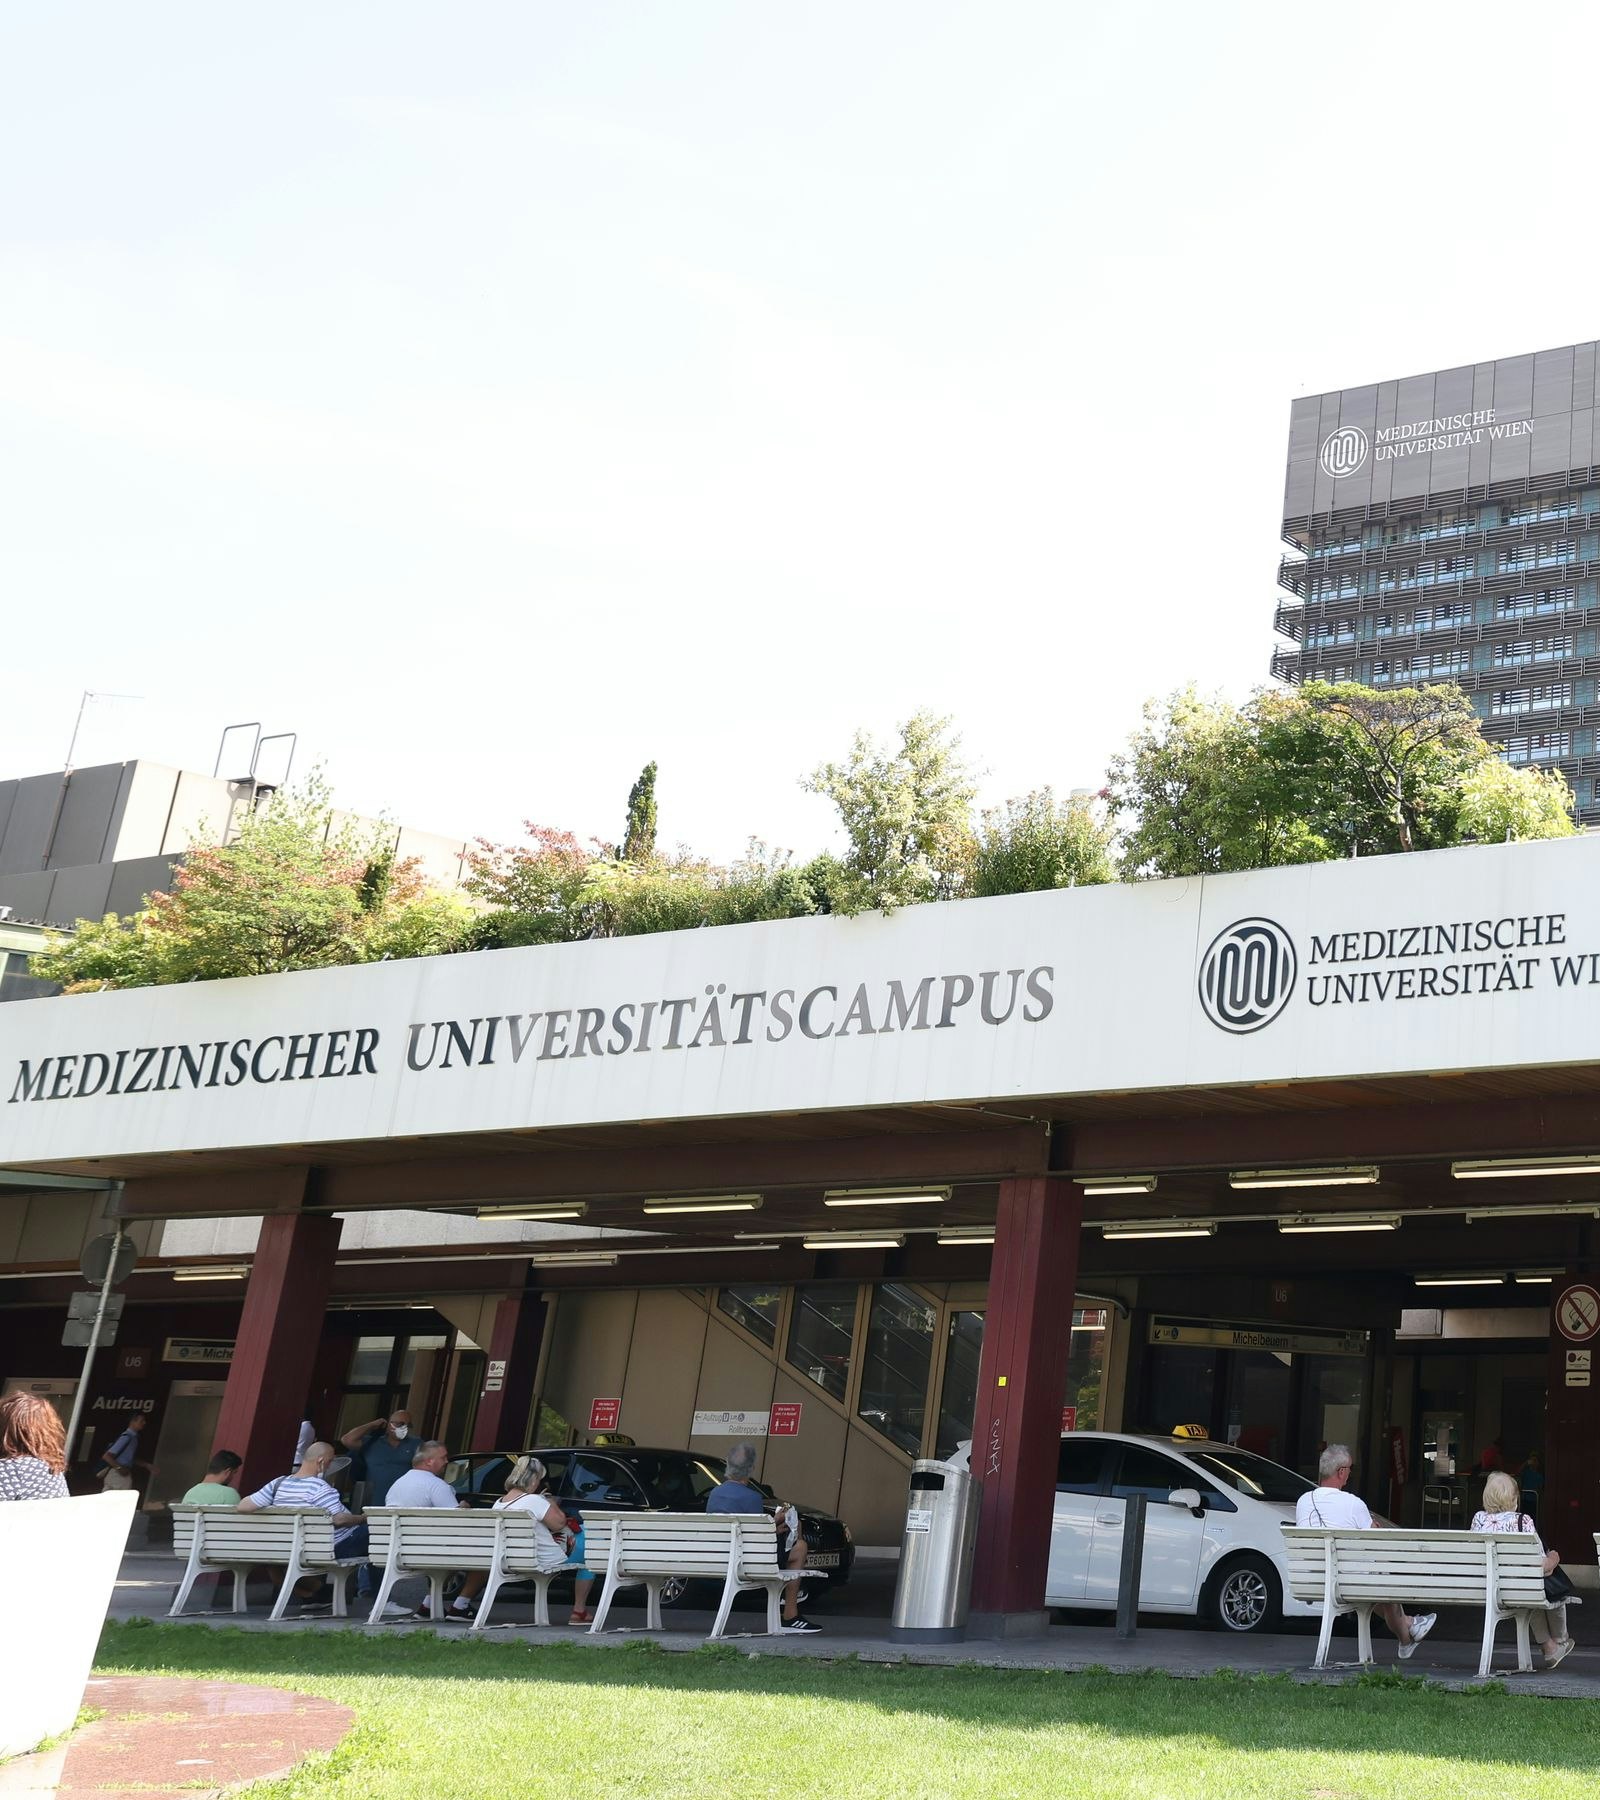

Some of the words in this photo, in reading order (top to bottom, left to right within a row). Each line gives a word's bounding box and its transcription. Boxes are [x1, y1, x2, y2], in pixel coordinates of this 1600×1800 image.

[1375, 409, 1496, 444] MEDIZINISCHE
[1375, 427, 1485, 461] UNIVERSITÄT
[1488, 419, 1535, 440] WIEN
[1308, 914, 1567, 965] MEDIZINISCHE
[1307, 950, 1540, 1007] UNIVERSITÄT
[11, 1027, 380, 1103] MEDIZINISCHER
[406, 965, 1055, 1072] UNIVERSITÄTSCAMPUS
[124, 1356, 143, 1368] U6
[92, 1396, 155, 1412] Aufzug
